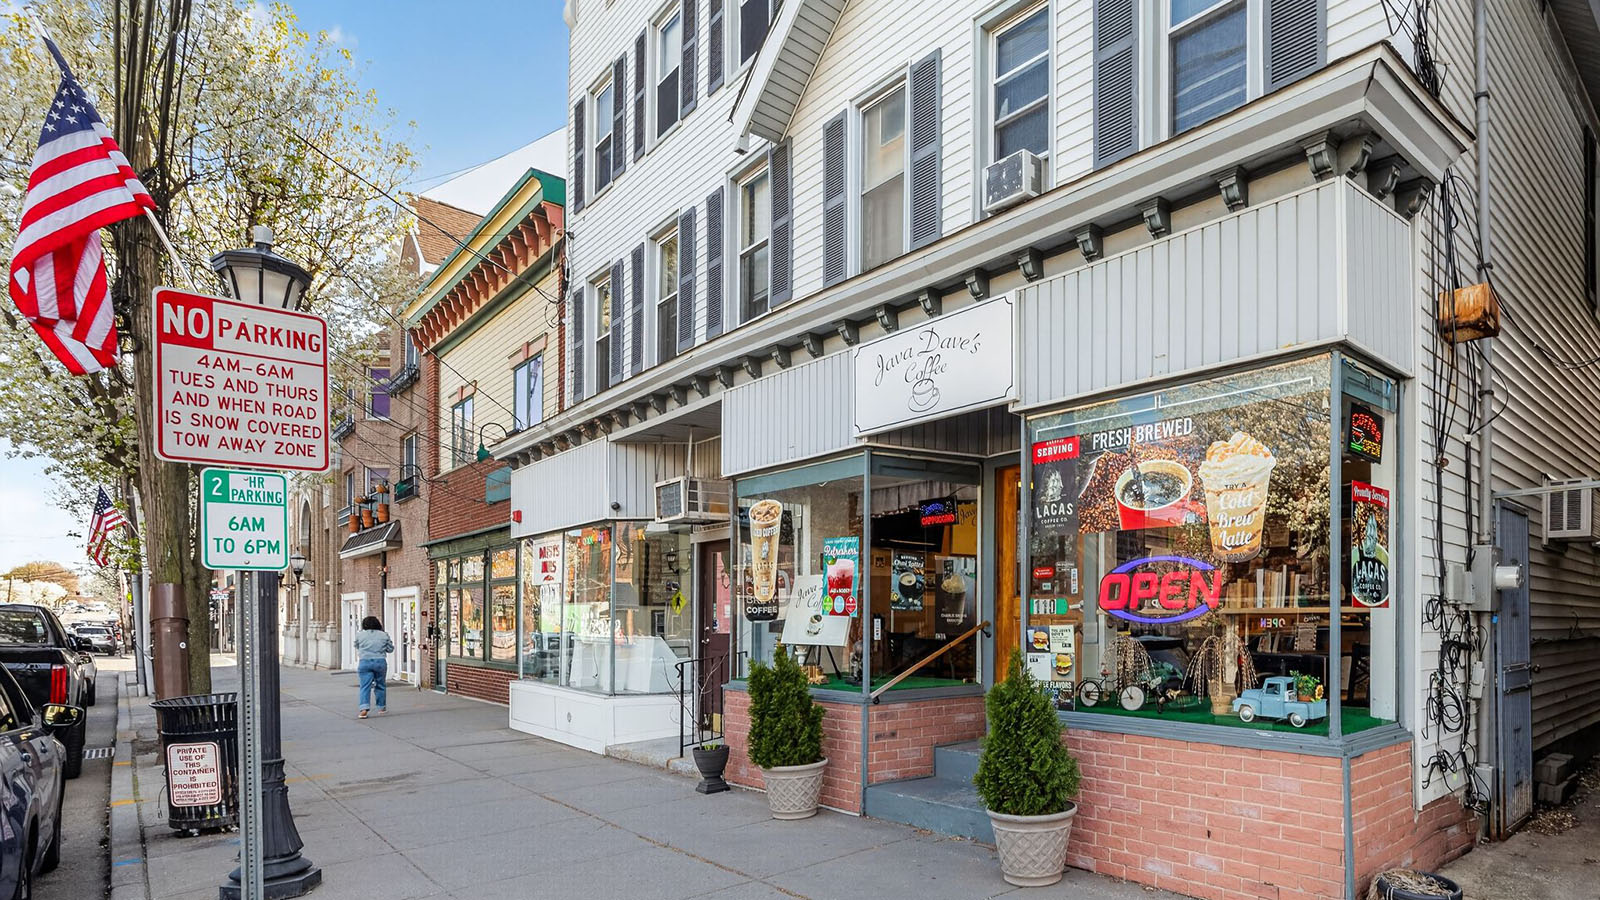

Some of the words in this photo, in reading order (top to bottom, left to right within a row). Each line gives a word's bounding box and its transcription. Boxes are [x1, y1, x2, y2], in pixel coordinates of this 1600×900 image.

[162, 302, 210, 339] NO
[218, 318, 321, 353] PARKING
[874, 346, 914, 387] Java
[917, 327, 981, 355] Dave's
[904, 353, 948, 384] Coffee
[169, 370, 215, 389] TUES
[223, 378, 259, 395] AND
[266, 383, 319, 402] THURS
[172, 391, 209, 408] AND
[217, 396, 265, 415] WHEN
[272, 403, 317, 420] ROAD
[165, 410, 182, 425] IS
[190, 412, 240, 431] SNOW
[248, 419, 322, 439] COVERED
[1092, 430, 1133, 450] FRESH
[1135, 418, 1193, 443] BREWED
[173, 431, 210, 448] TOW
[217, 436, 266, 453] AWAY
[275, 441, 316, 458] ZONE
[1037, 443, 1073, 457] SERVING
[211, 477, 223, 496] 2
[249, 476, 265, 490] HR
[231, 488, 283, 504] PARKING
[1036, 502, 1074, 519] LACAS
[1218, 491, 1254, 510] Cold
[229, 516, 265, 532] 6AM
[1217, 512, 1255, 529] Brew
[213, 537, 235, 554] TO
[244, 538, 280, 555] 6PM
[1219, 530, 1252, 551] Latte
[1356, 561, 1386, 582] LACAS
[1099, 569, 1223, 611] OPEN
[746, 606, 777, 614] COFFEE
[1035, 599, 1056, 614] 110
[173, 767, 215, 776] CONTAINER
[173, 782, 216, 790] PROHIBITED
